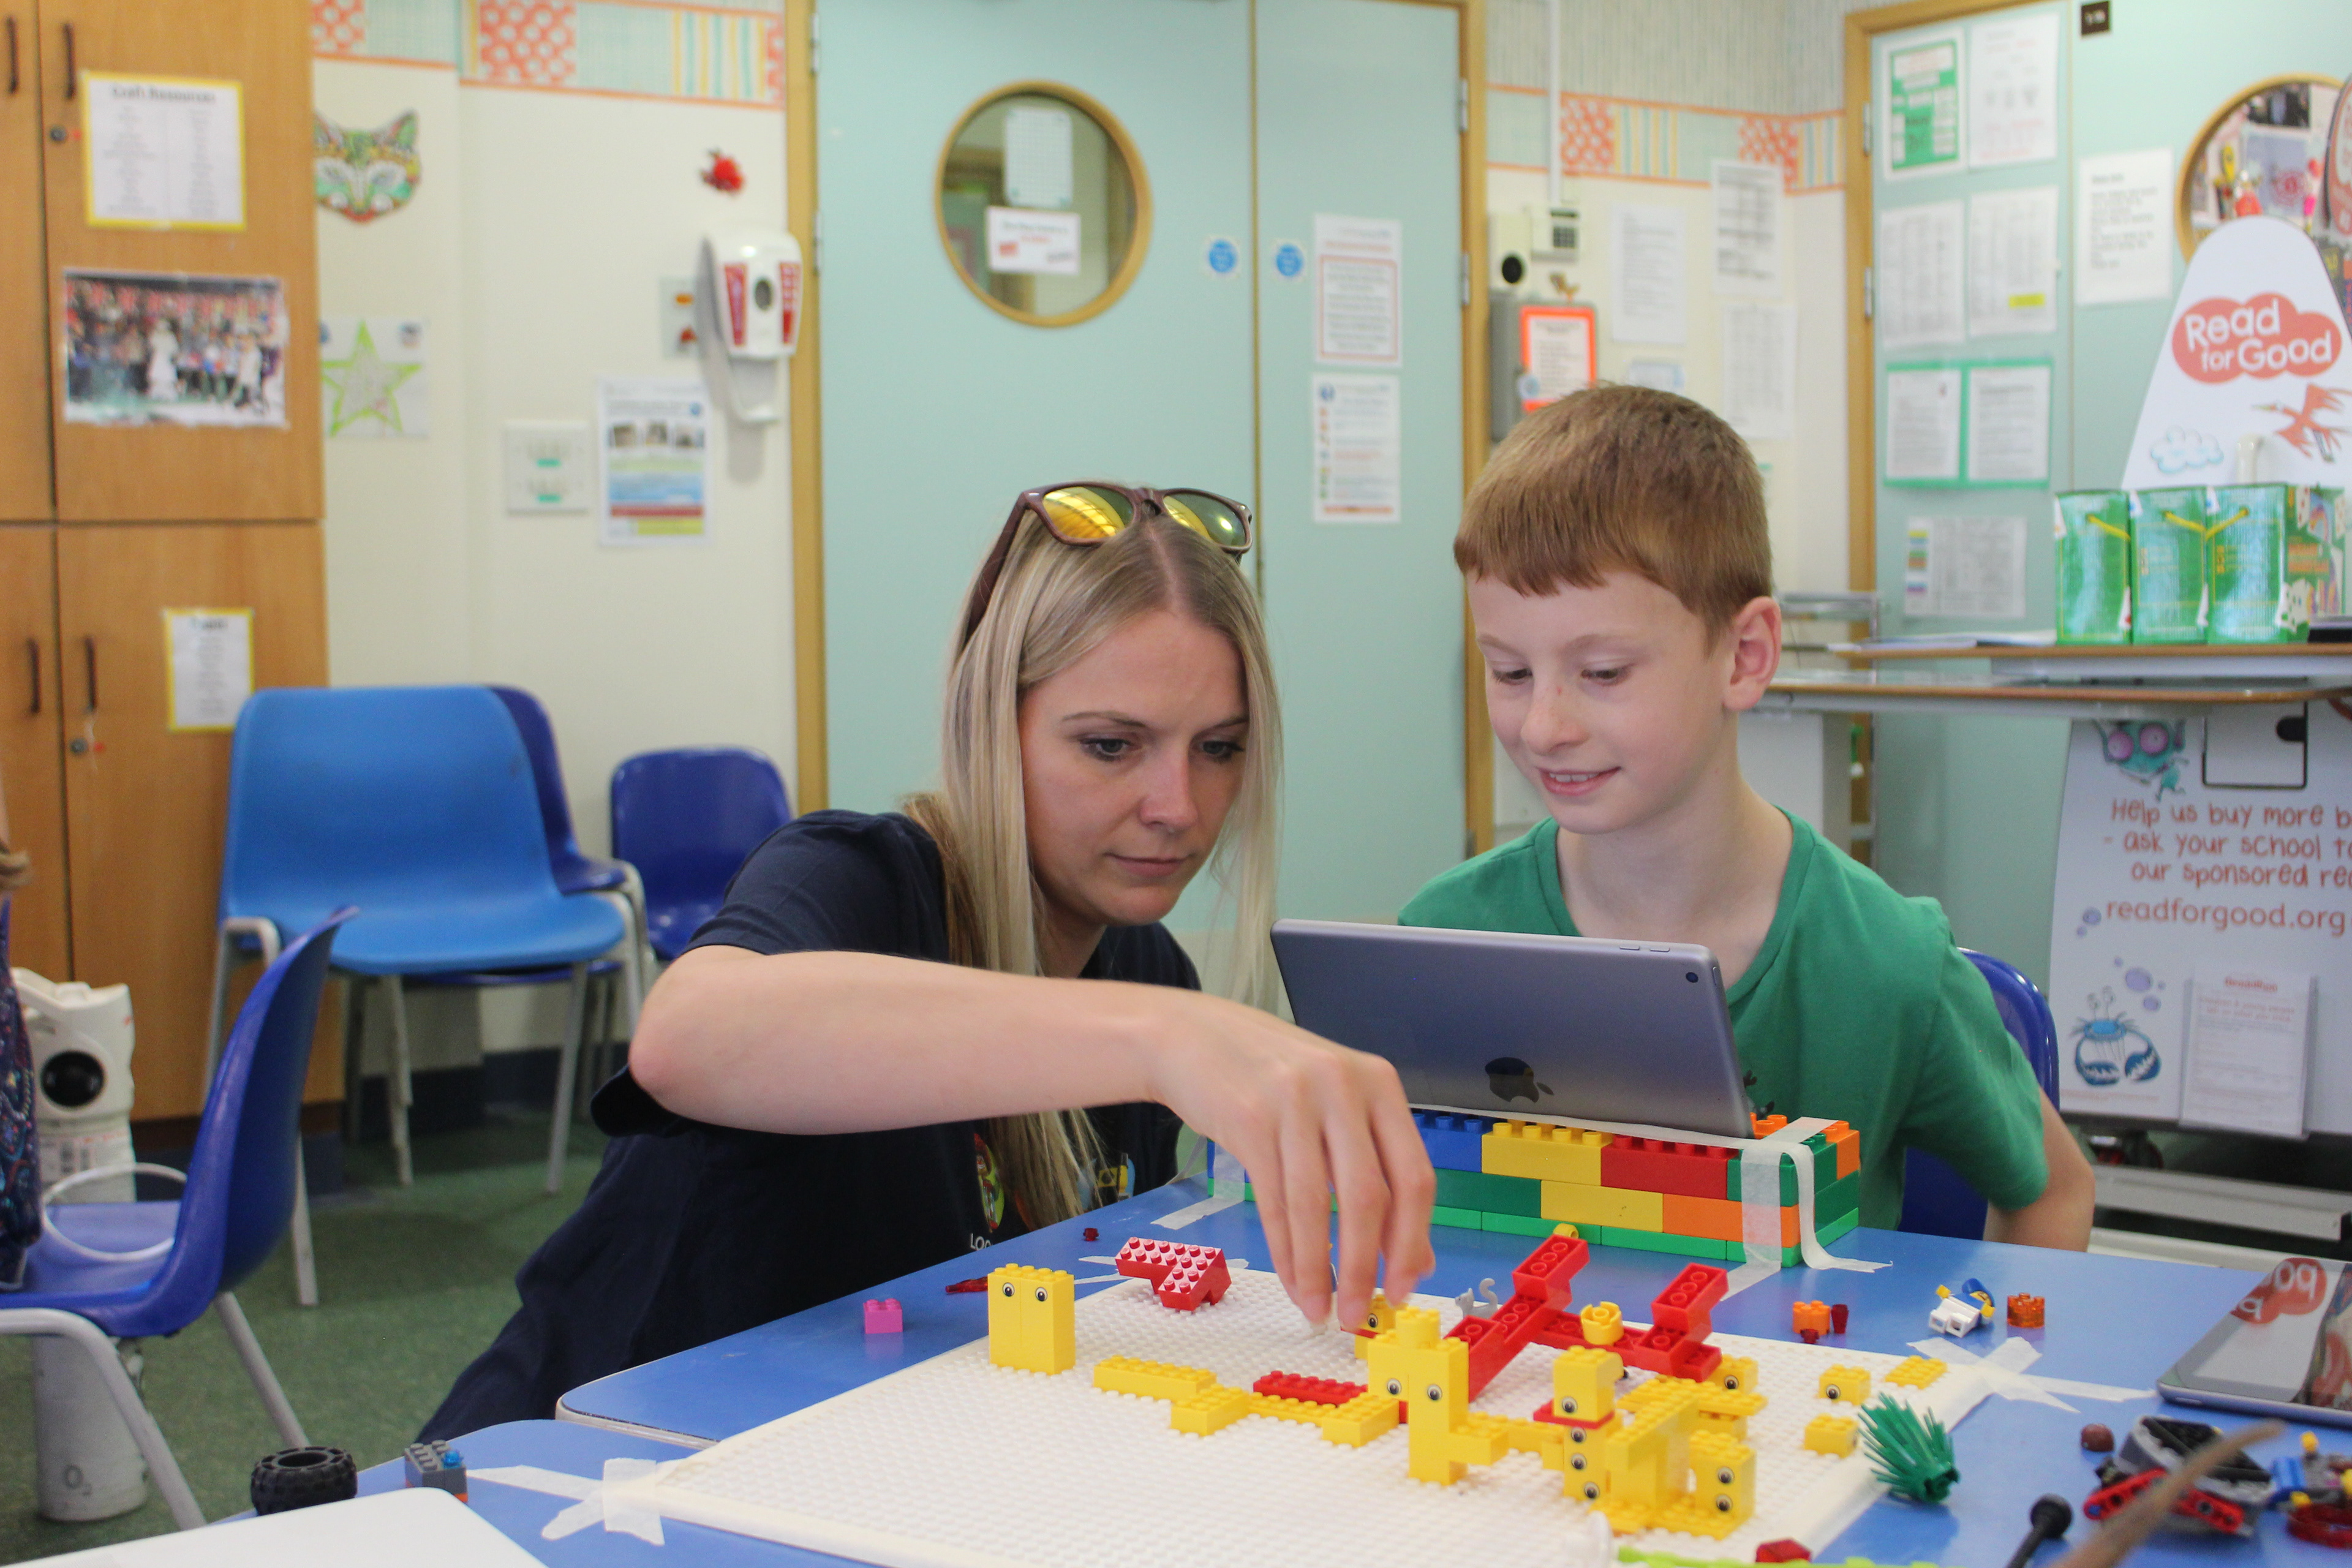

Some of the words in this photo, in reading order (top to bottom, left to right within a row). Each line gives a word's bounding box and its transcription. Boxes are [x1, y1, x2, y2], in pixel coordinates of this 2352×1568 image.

[2185, 296, 2281, 353] Read
[2201, 345, 2234, 373] for
[2237, 329, 2332, 372] Good
[2111, 798, 2161, 828] Help
[2170, 804, 2198, 823] us
[2208, 802, 2253, 829] buy
[2263, 804, 2324, 827] more
[2123, 829, 2164, 853] ask
[2175, 833, 2229, 858] your
[2241, 833, 2321, 862] school
[2131, 861, 2171, 881] our
[2182, 862, 2309, 891] sponsored
[2106, 896, 2346, 939] readforgood.org
